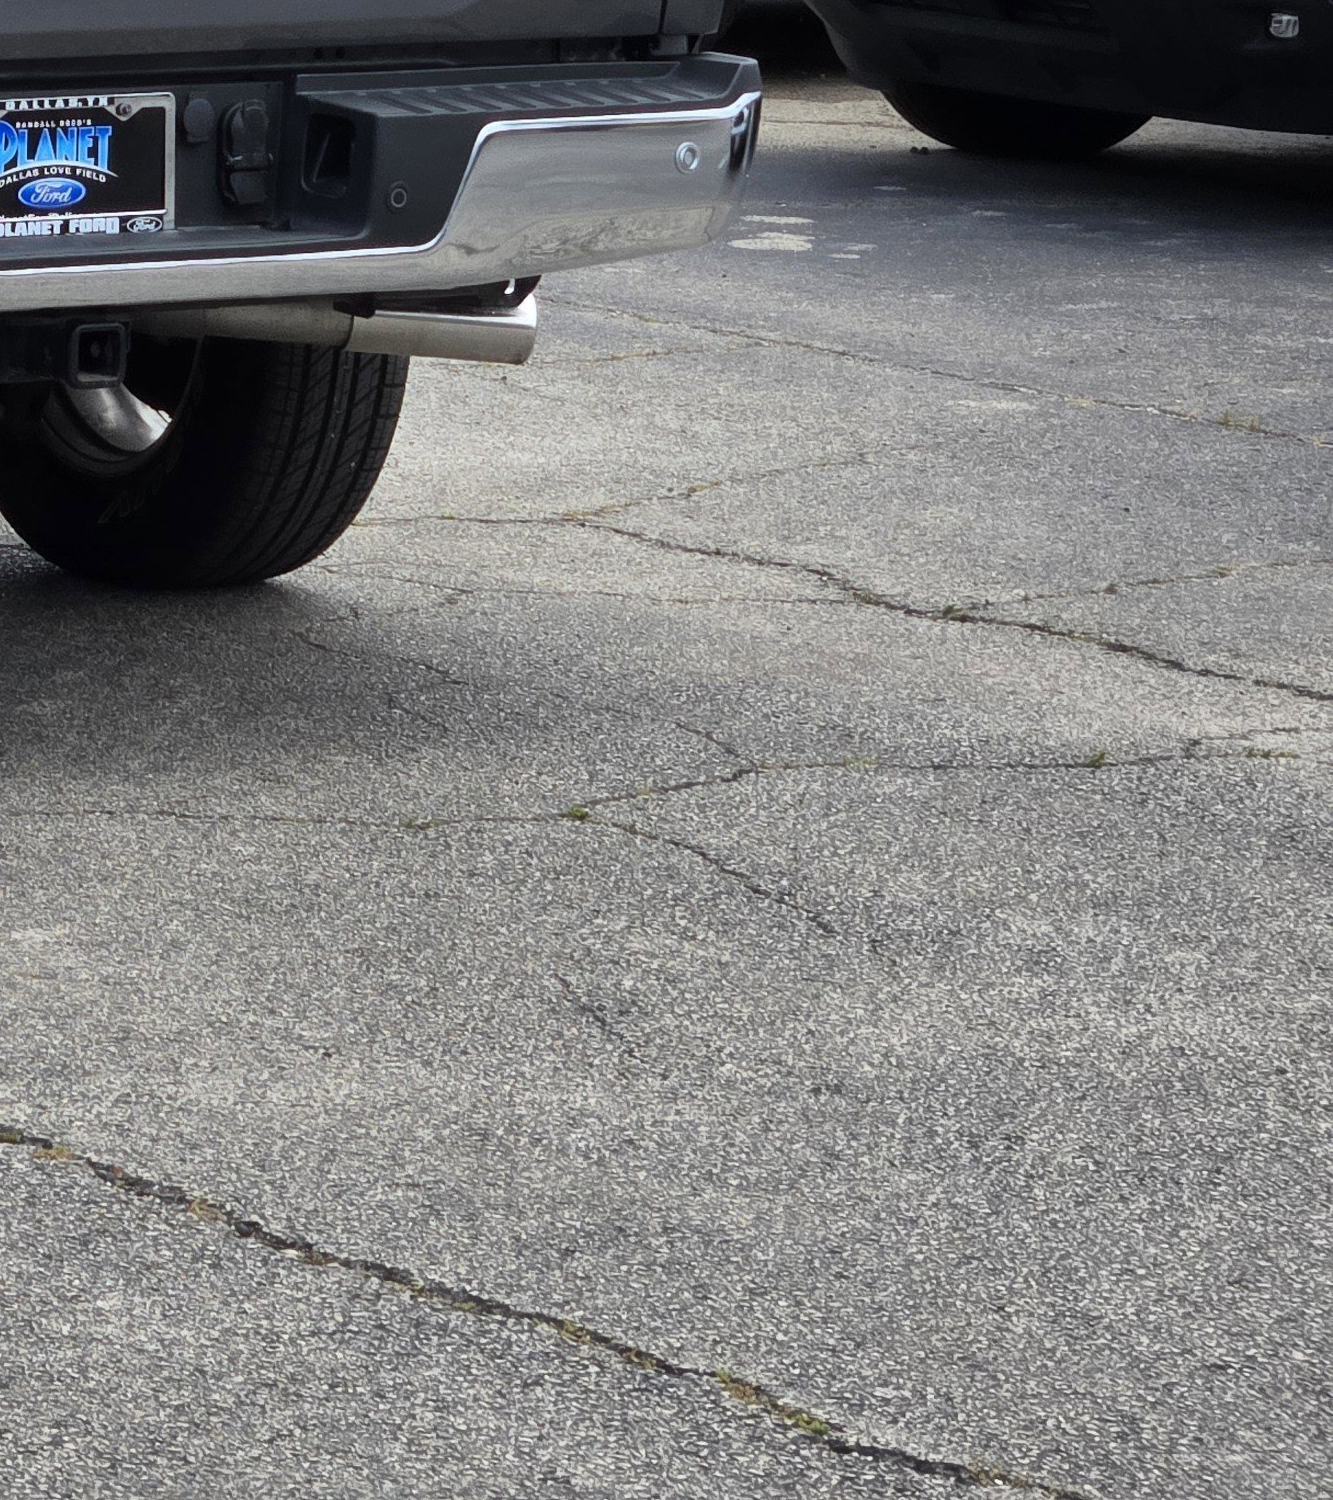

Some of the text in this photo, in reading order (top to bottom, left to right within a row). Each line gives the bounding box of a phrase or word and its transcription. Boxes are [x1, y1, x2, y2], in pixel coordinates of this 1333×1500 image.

[43, 166, 72, 176] LOVE
[75, 168, 107, 183] FIELD
[30, 180, 74, 204] Ford
[68, 217, 120, 234] FORD
